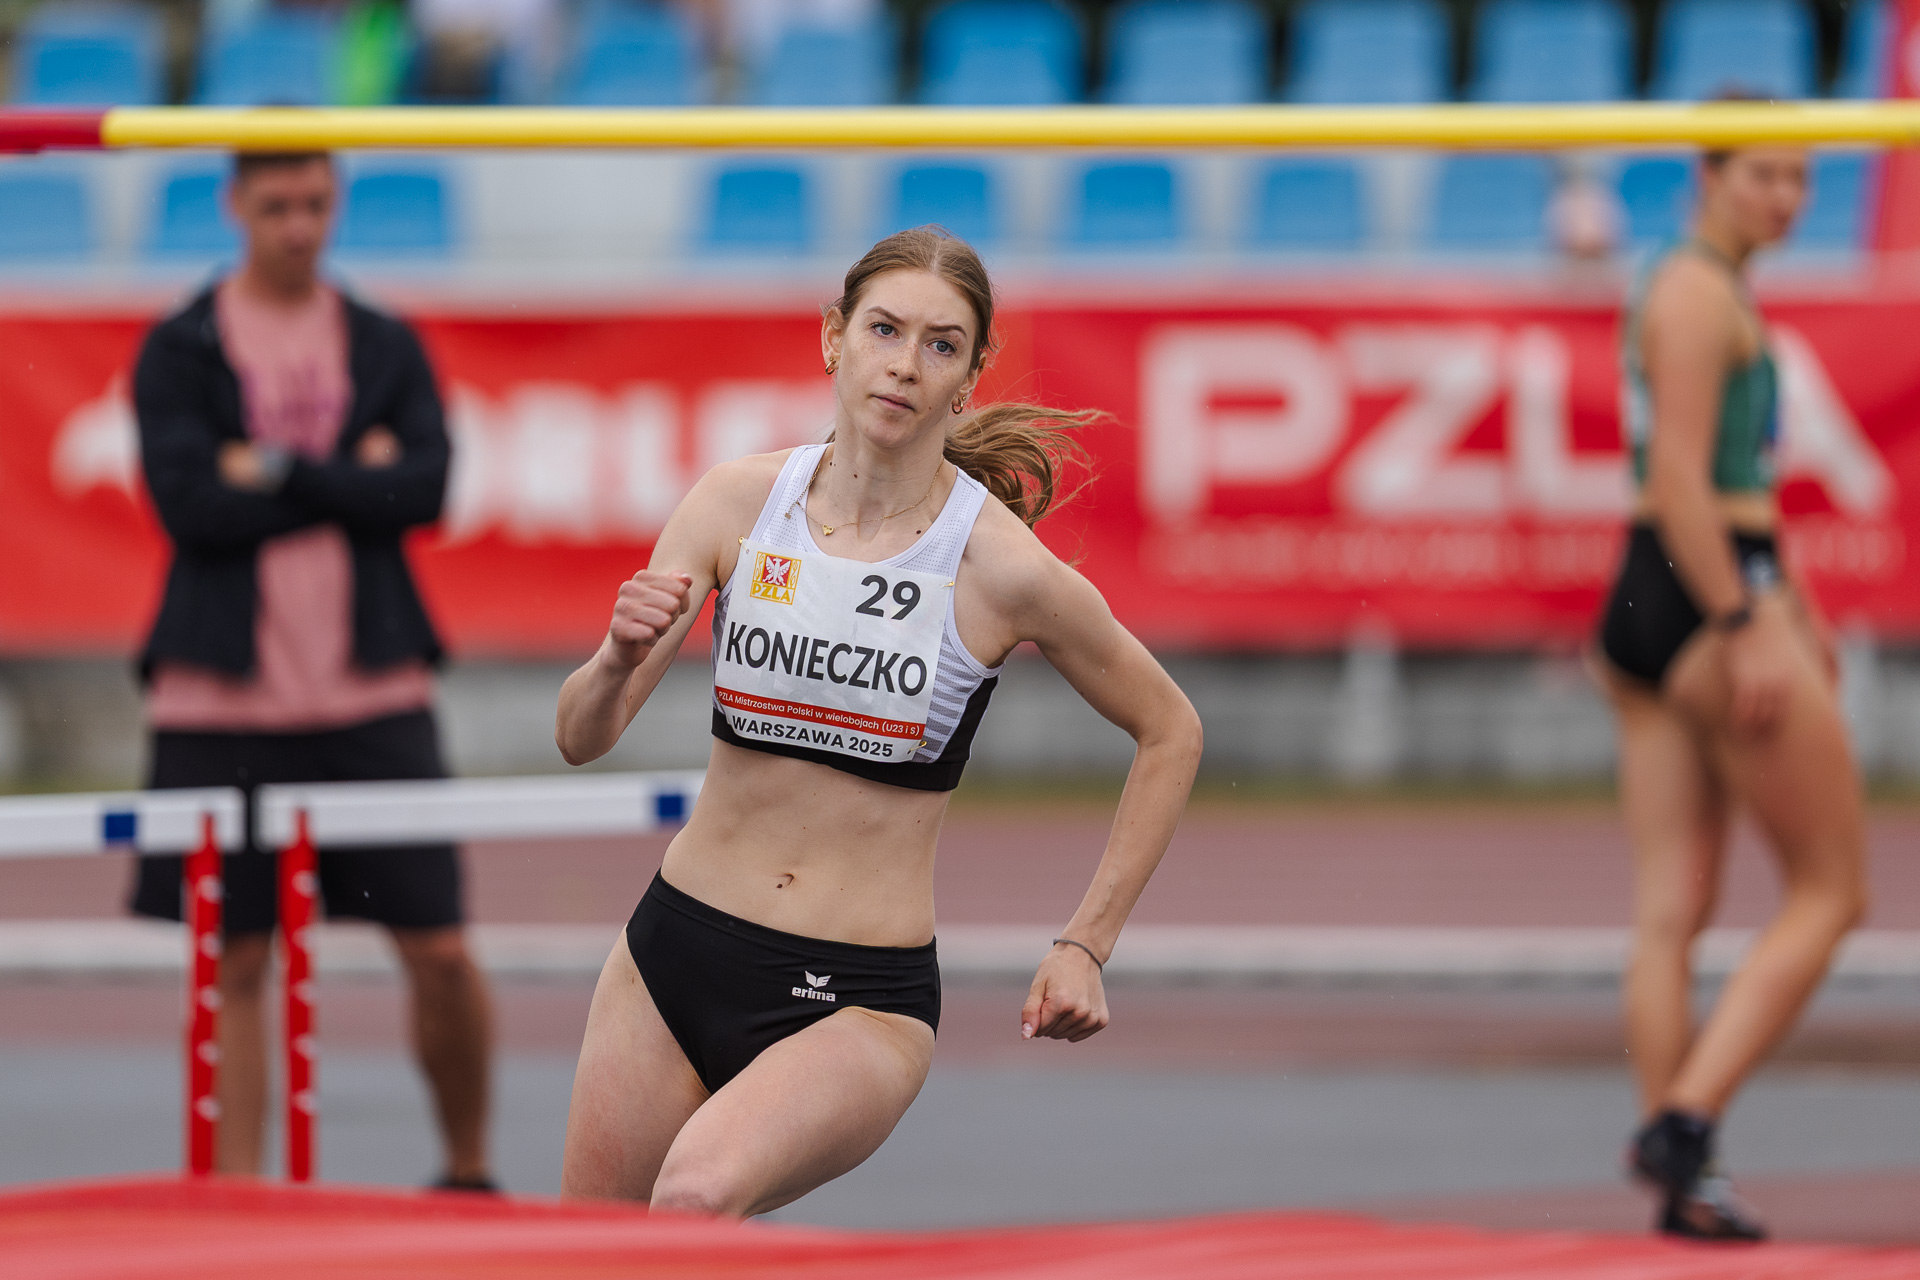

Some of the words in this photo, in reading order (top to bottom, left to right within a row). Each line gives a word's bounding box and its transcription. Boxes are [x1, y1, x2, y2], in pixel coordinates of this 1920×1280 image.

[752, 583, 791, 602] PZLA
[855, 574, 921, 621] 29
[725, 621, 928, 697] KONIECZKO
[718, 691, 734, 702] PZLA
[735, 695, 785, 712] Mistrzostwa
[787, 705, 814, 717] Polski
[815, 711, 824, 719] w
[825, 712, 880, 730] wielobojach
[882, 721, 904, 734] (U23
[910, 725, 920, 737] S)
[732, 715, 844, 749] WARSZAWA
[848, 736, 894, 757] 2025
[791, 986, 836, 1002] erima
